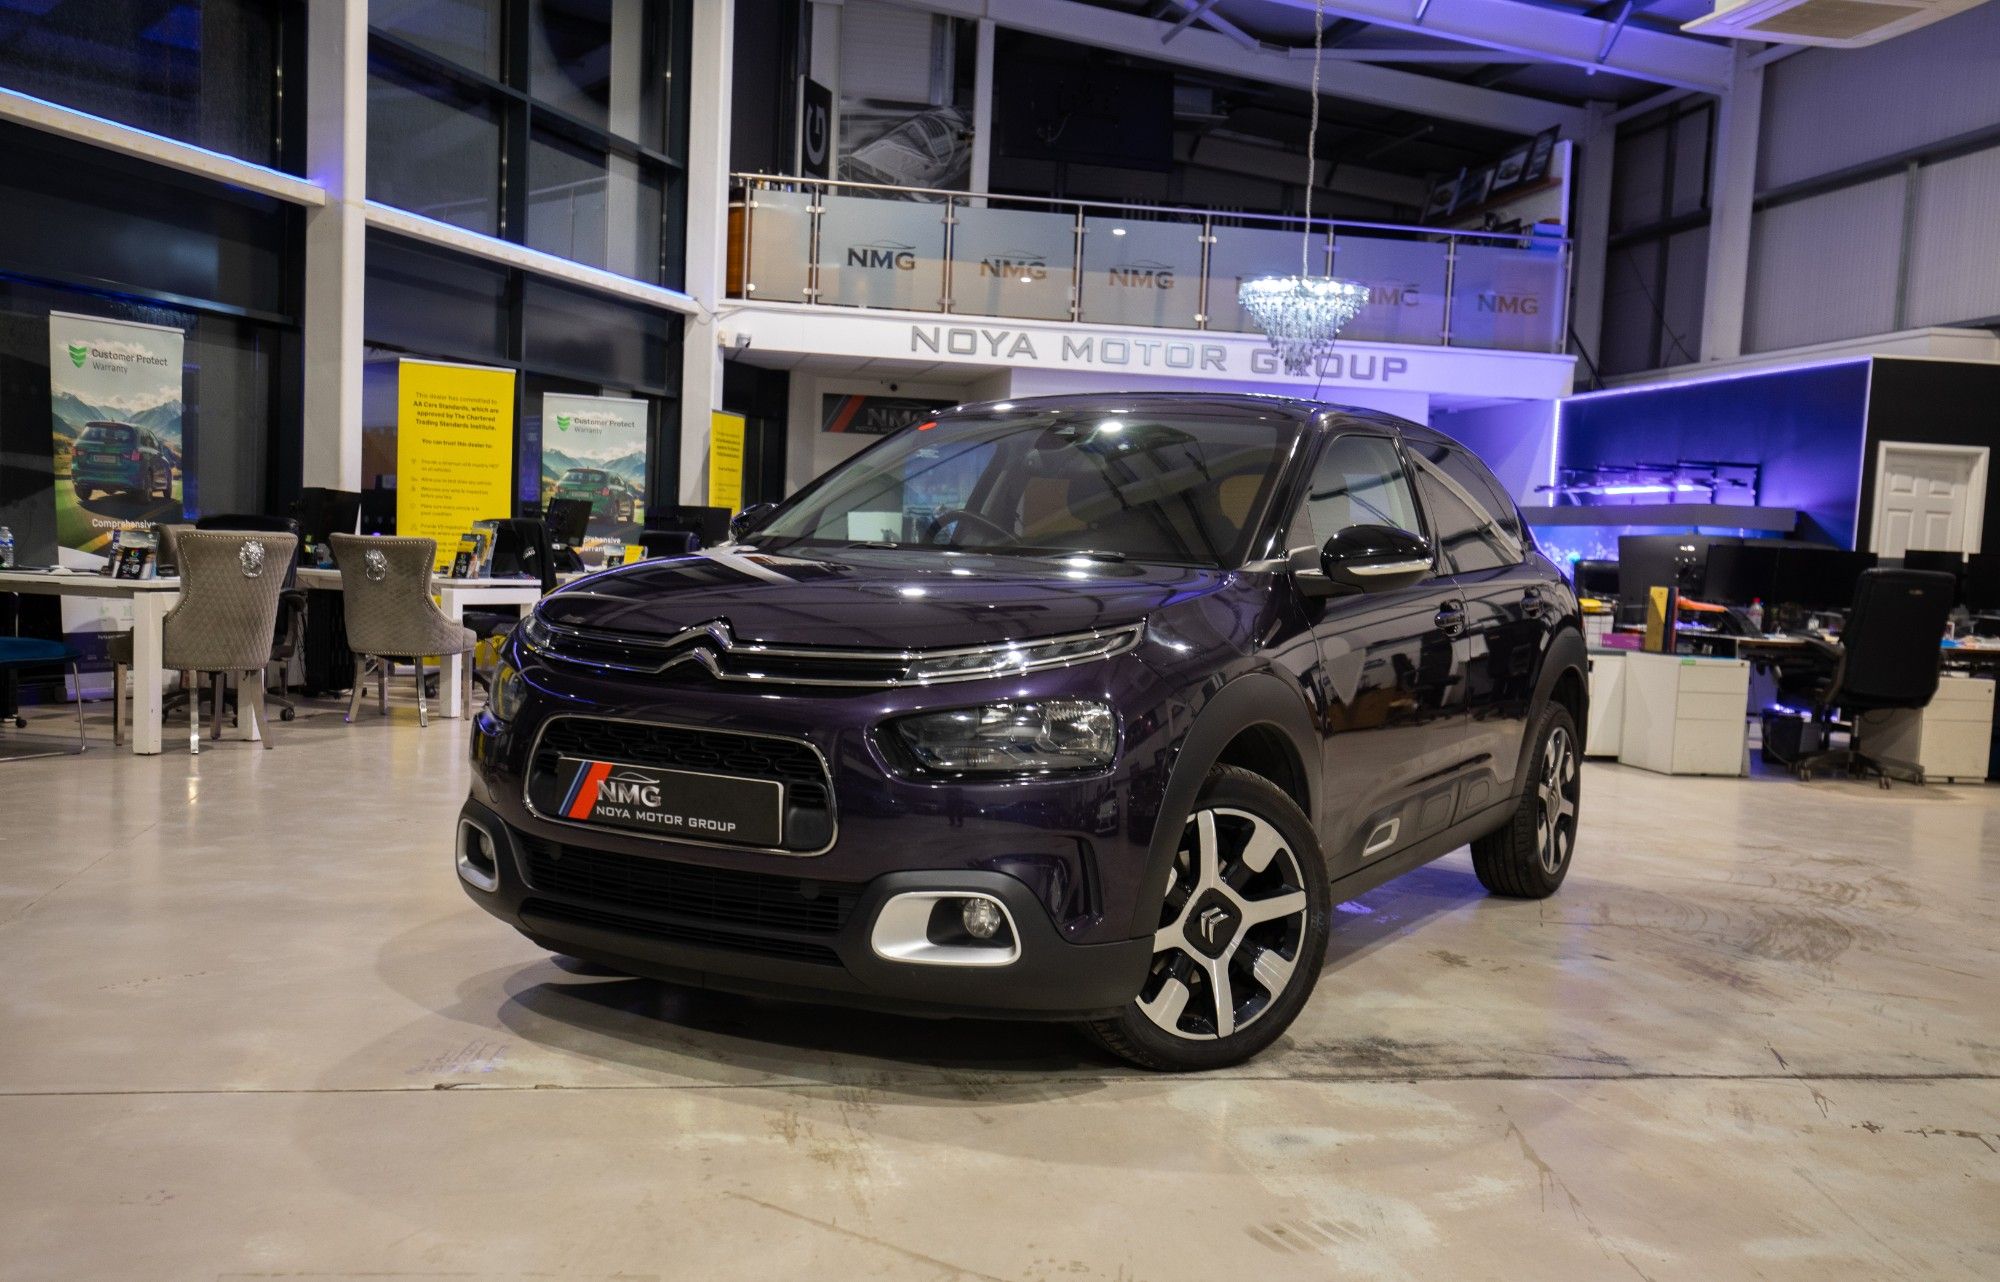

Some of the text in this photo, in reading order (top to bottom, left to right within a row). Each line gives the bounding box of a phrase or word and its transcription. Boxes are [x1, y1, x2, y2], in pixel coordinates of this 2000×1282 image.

[847, 246, 916, 272] NMG
[980, 257, 1048, 281] NMG
[1109, 266, 1175, 290] NMG
[1478, 292, 1539, 316] NMG
[92, 348, 168, 366] Customer Protect
[911, 324, 1038, 361] NOYA
[1062, 335, 1227, 372] MOTOR
[92, 361, 128, 374] Warranty
[415, 418, 439, 427] Trading
[439, 420, 469, 429] Standards
[416, 410, 445, 418] approved
[466, 414, 496, 422] Chartered
[574, 417, 635, 429] Customer Protect
[574, 427, 603, 436] Warranty
[583, 536, 621, 545] prehensive
[597, 779, 662, 807] NMG
[596, 805, 737, 832] NOYA MOTOR GROUP
